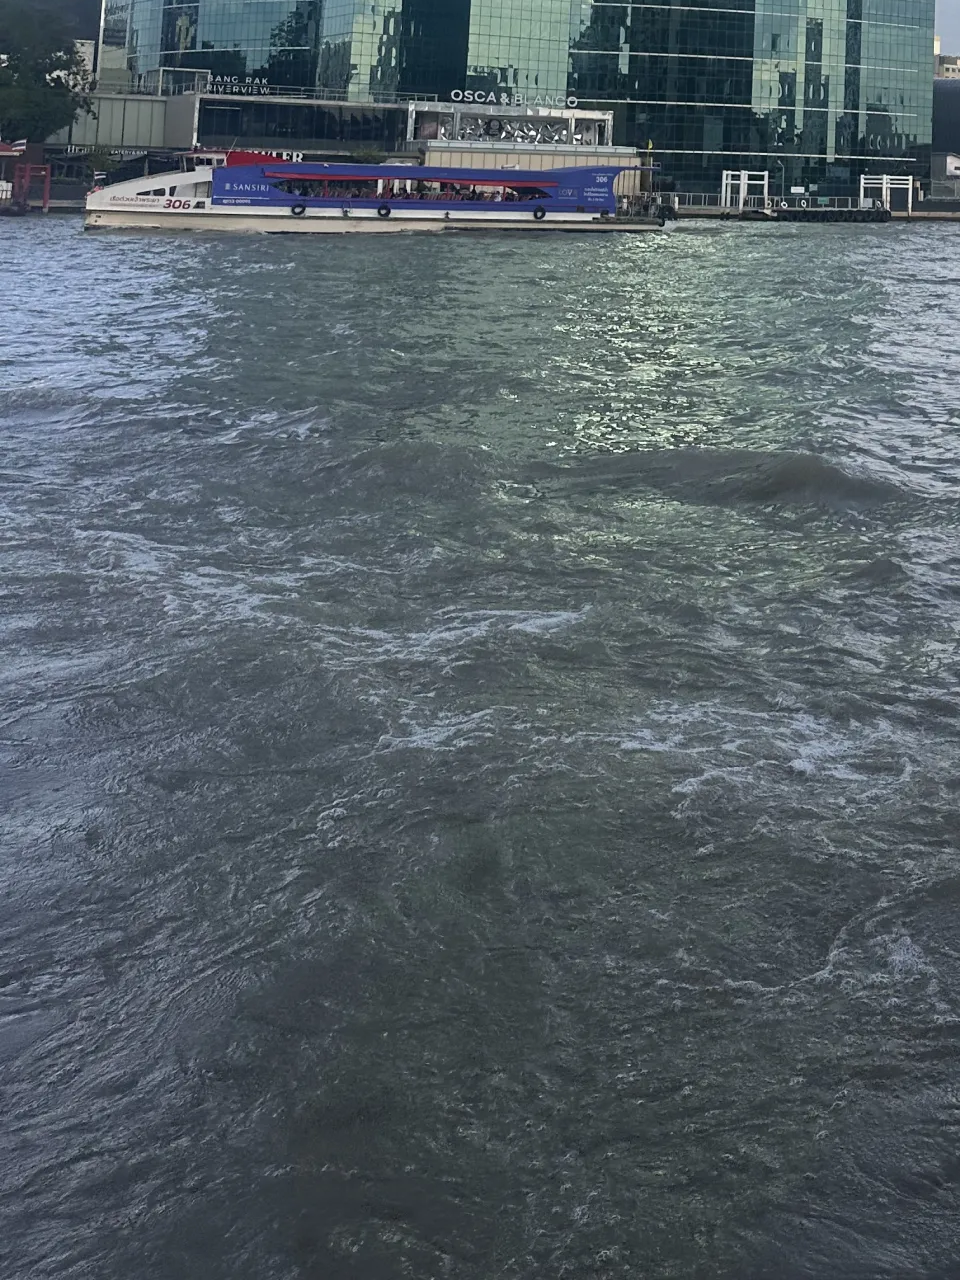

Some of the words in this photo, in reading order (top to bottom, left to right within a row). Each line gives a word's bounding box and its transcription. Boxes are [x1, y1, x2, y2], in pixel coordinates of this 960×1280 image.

[207, 74, 239, 84] BANG
[245, 76, 269, 85] RAK
[206, 84, 270, 95] RIVERVIEW
[450, 89, 497, 102] OSCA
[499, 92, 510, 104] &
[514, 93, 578, 107] BLANCO
[233, 183, 269, 192] SANSIRI
[163, 199, 191, 209] 306
